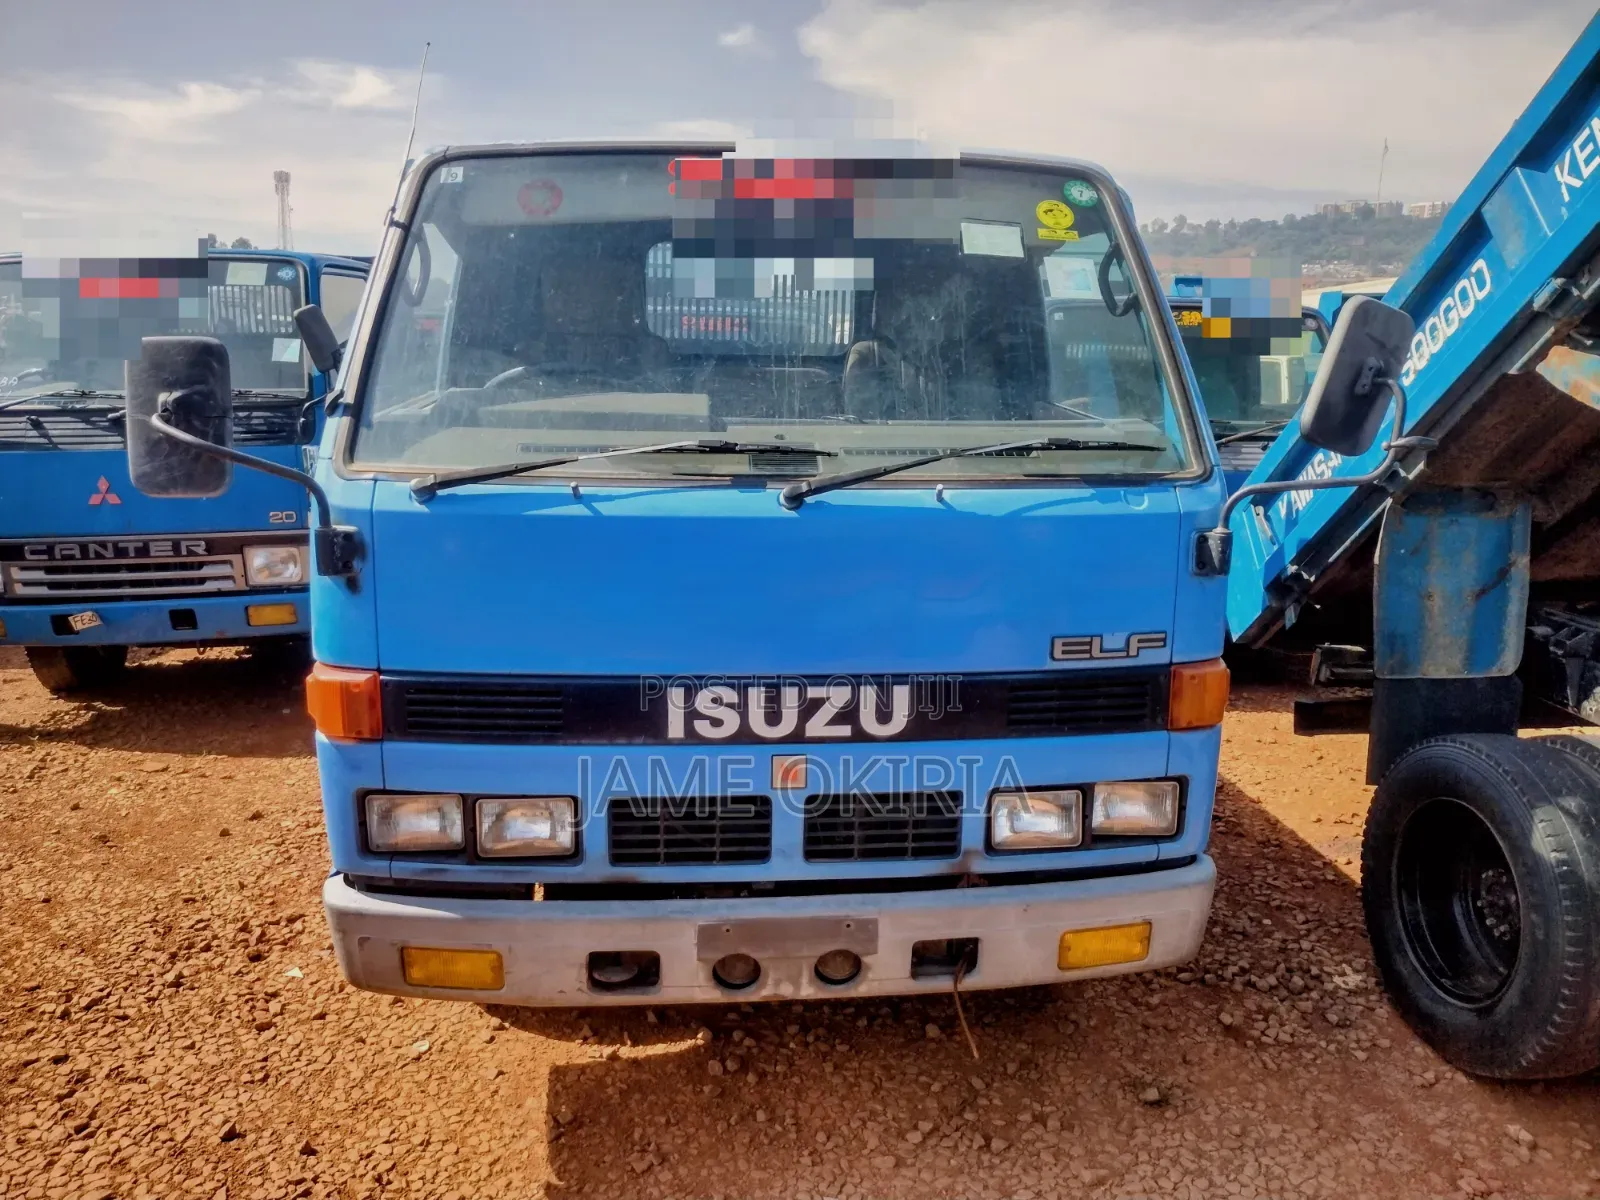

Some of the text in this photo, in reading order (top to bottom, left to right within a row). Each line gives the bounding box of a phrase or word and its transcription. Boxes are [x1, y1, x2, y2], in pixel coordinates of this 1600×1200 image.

[1554, 117, 1600, 203] KE
[269, 511, 297, 523] 20
[24, 540, 208, 560] CANTER
[1051, 631, 1167, 660] ELF
[667, 684, 910, 738] ISUZU
